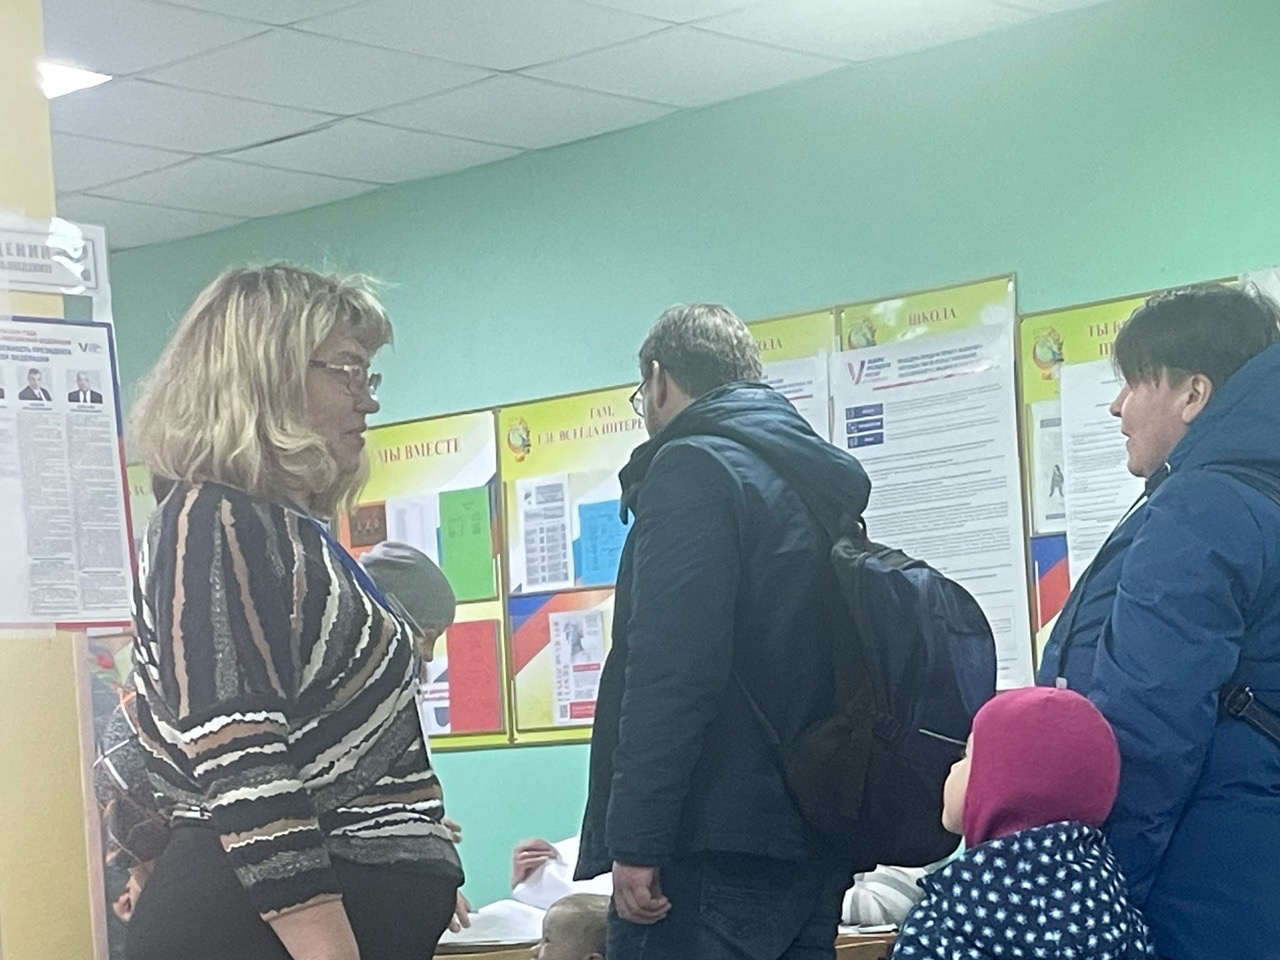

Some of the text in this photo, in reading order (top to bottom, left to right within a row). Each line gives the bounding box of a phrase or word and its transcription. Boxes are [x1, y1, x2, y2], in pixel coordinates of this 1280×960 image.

[908, 307, 957, 327] ШКОЛА
[757, 337, 783, 353] ОЛА
[601, 417, 645, 436] ИНТЕРЕ
[404, 437, 461, 460] ВМЕСТЕ
